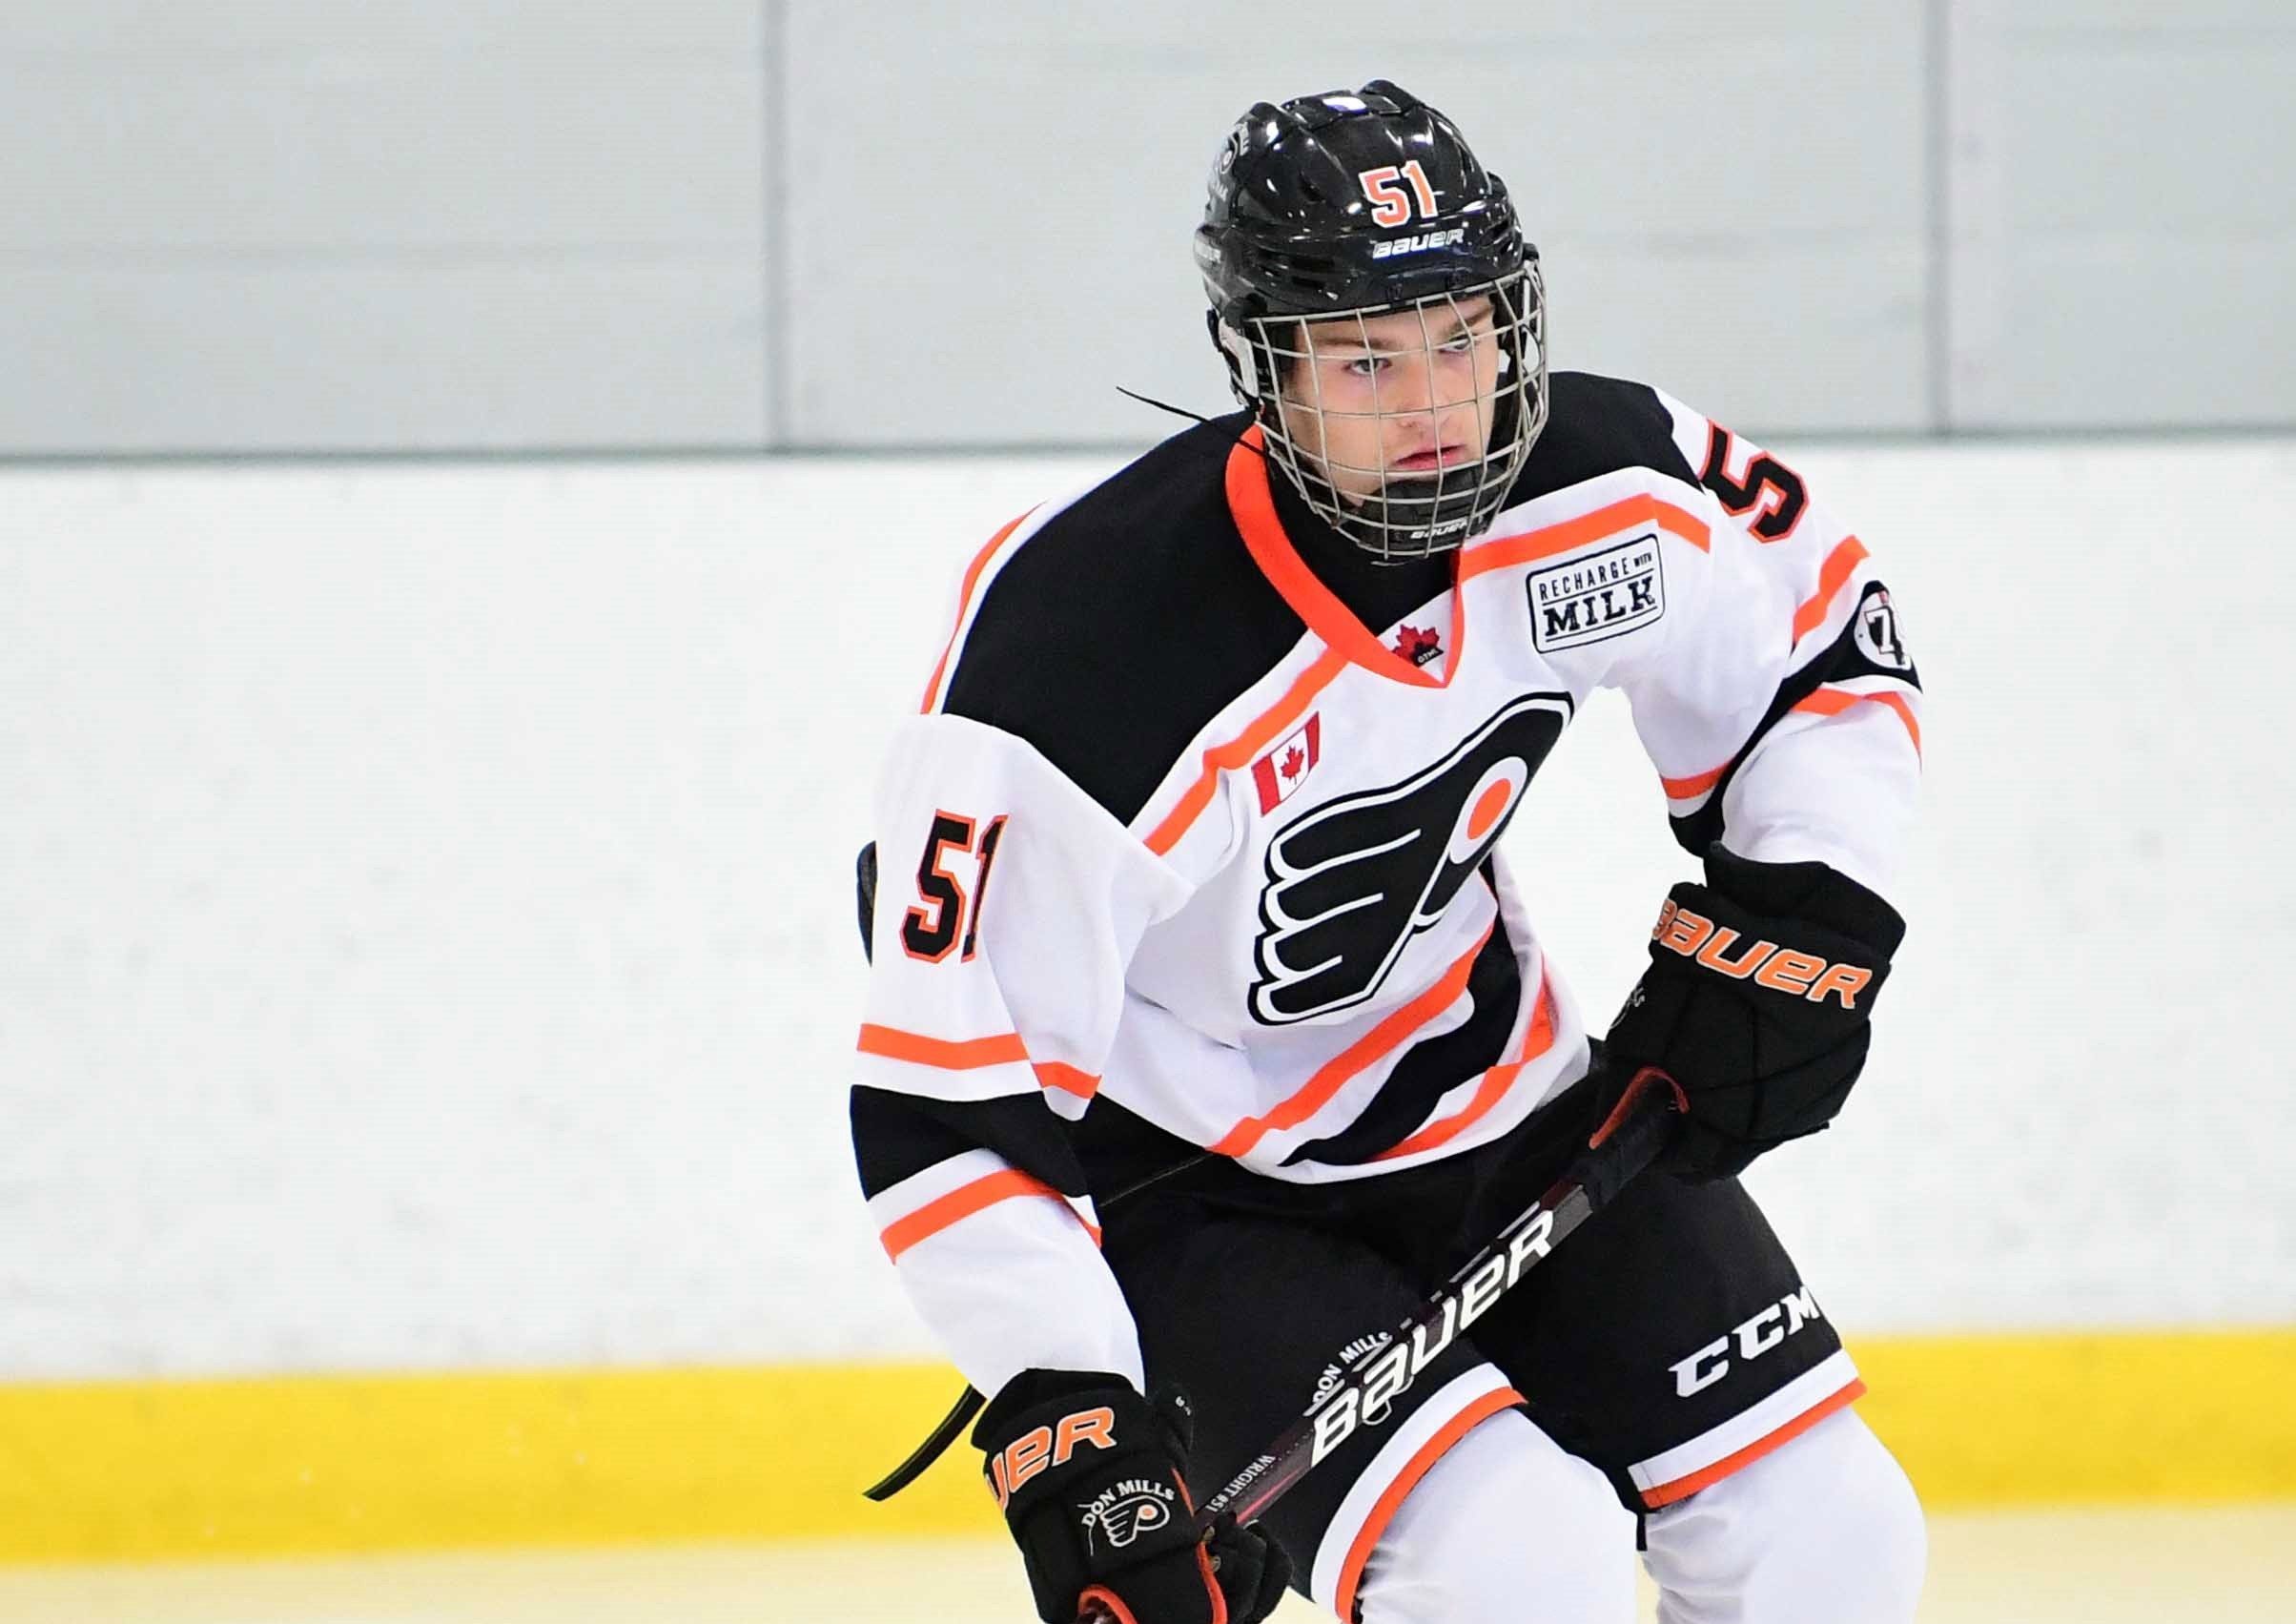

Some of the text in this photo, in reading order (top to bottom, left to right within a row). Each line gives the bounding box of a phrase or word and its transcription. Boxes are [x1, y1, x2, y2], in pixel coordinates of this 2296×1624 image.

[1359, 159, 1440, 229] 51
[1373, 229, 1465, 259] BAUER
[1539, 557, 1630, 601] RECHARGE
[1543, 575, 1656, 637] MILK
[899, 809, 1010, 964] 51
[1312, 1210, 1553, 1468] BAUER
[1668, 1285, 1820, 1398] CCM
[1312, 1363, 1343, 1404] DON
[985, 1406, 1117, 1514] UER
[1223, 1454, 1276, 1497] WRIGHT
[1081, 1479, 1175, 1527] DON MILLS
